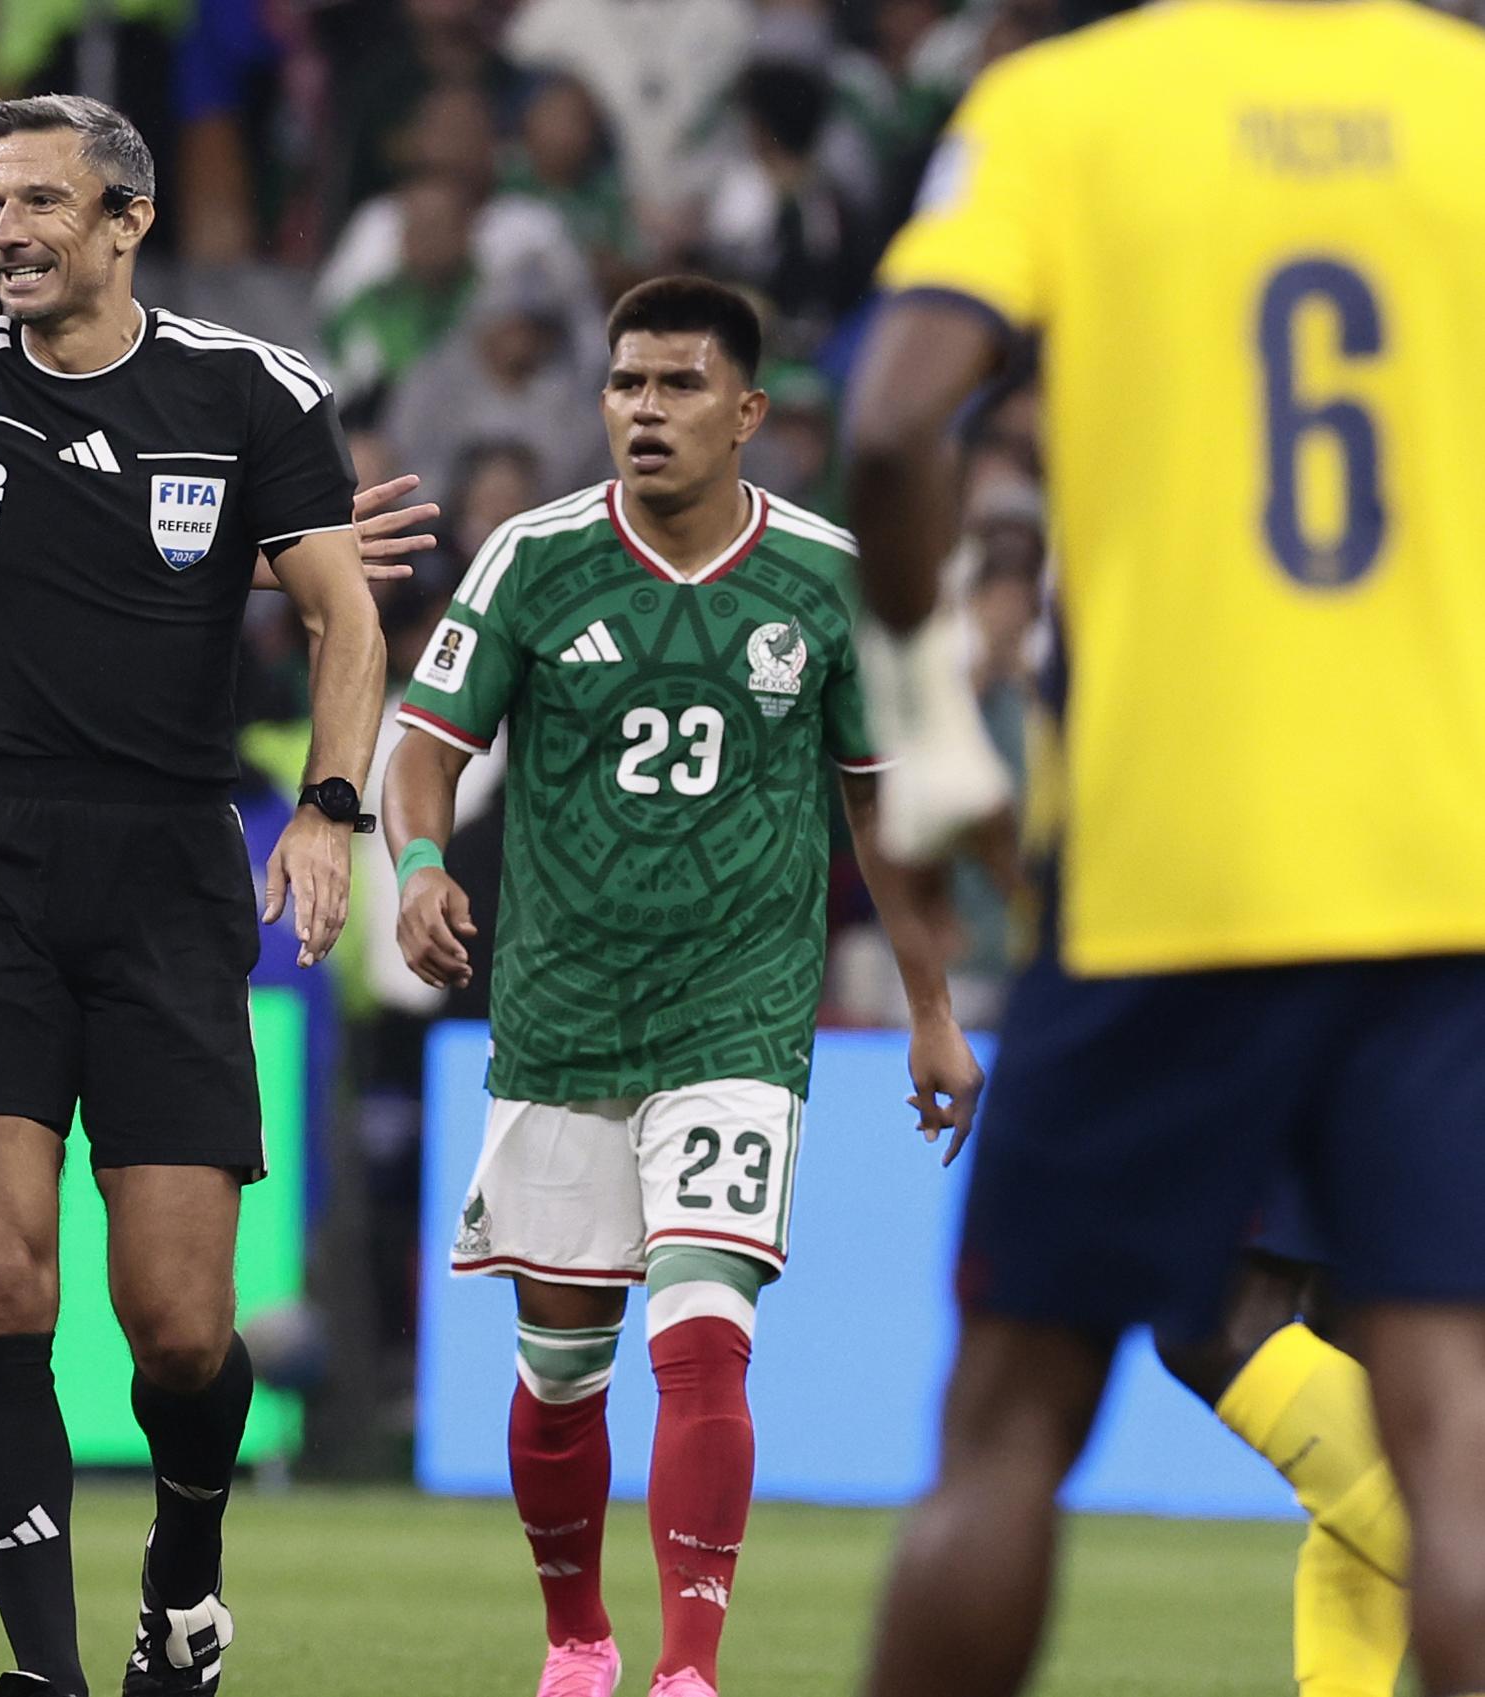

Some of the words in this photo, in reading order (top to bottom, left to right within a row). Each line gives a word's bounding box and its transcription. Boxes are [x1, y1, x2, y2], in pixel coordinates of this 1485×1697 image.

[1259, 259, 1383, 588] 6
[159, 482, 216, 507] FIFA
[157, 519, 212, 533] REFEREE
[169, 550, 195, 562] 2026
[615, 705, 725, 796] 23
[676, 1126, 772, 1215] 23
